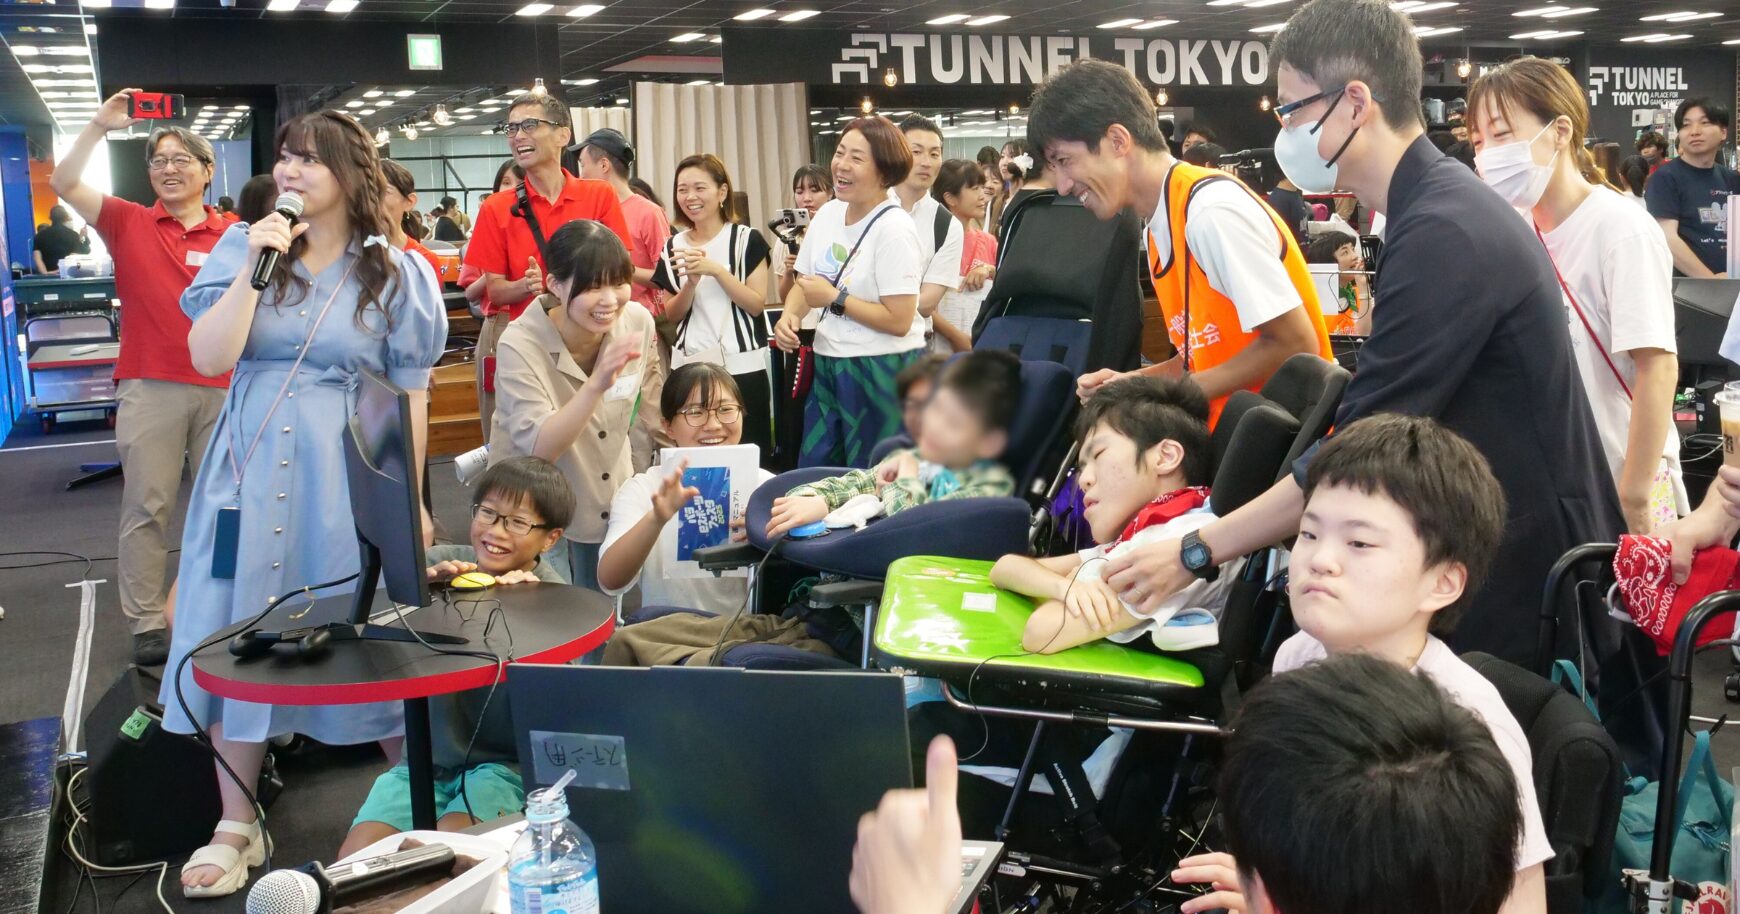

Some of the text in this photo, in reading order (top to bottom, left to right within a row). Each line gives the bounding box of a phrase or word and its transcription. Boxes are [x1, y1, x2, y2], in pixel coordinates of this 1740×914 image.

[1114, 38, 1269, 86] TOKYO
[1611, 66, 1689, 90] TUNNEL
[1611, 91, 1650, 106] TOKYO
[1655, 91, 1669, 99] PLACE
[1669, 91, 1679, 99] FOR
[715, 504, 725, 525] 2025
[544, 741, 621, 768] ステージ用
